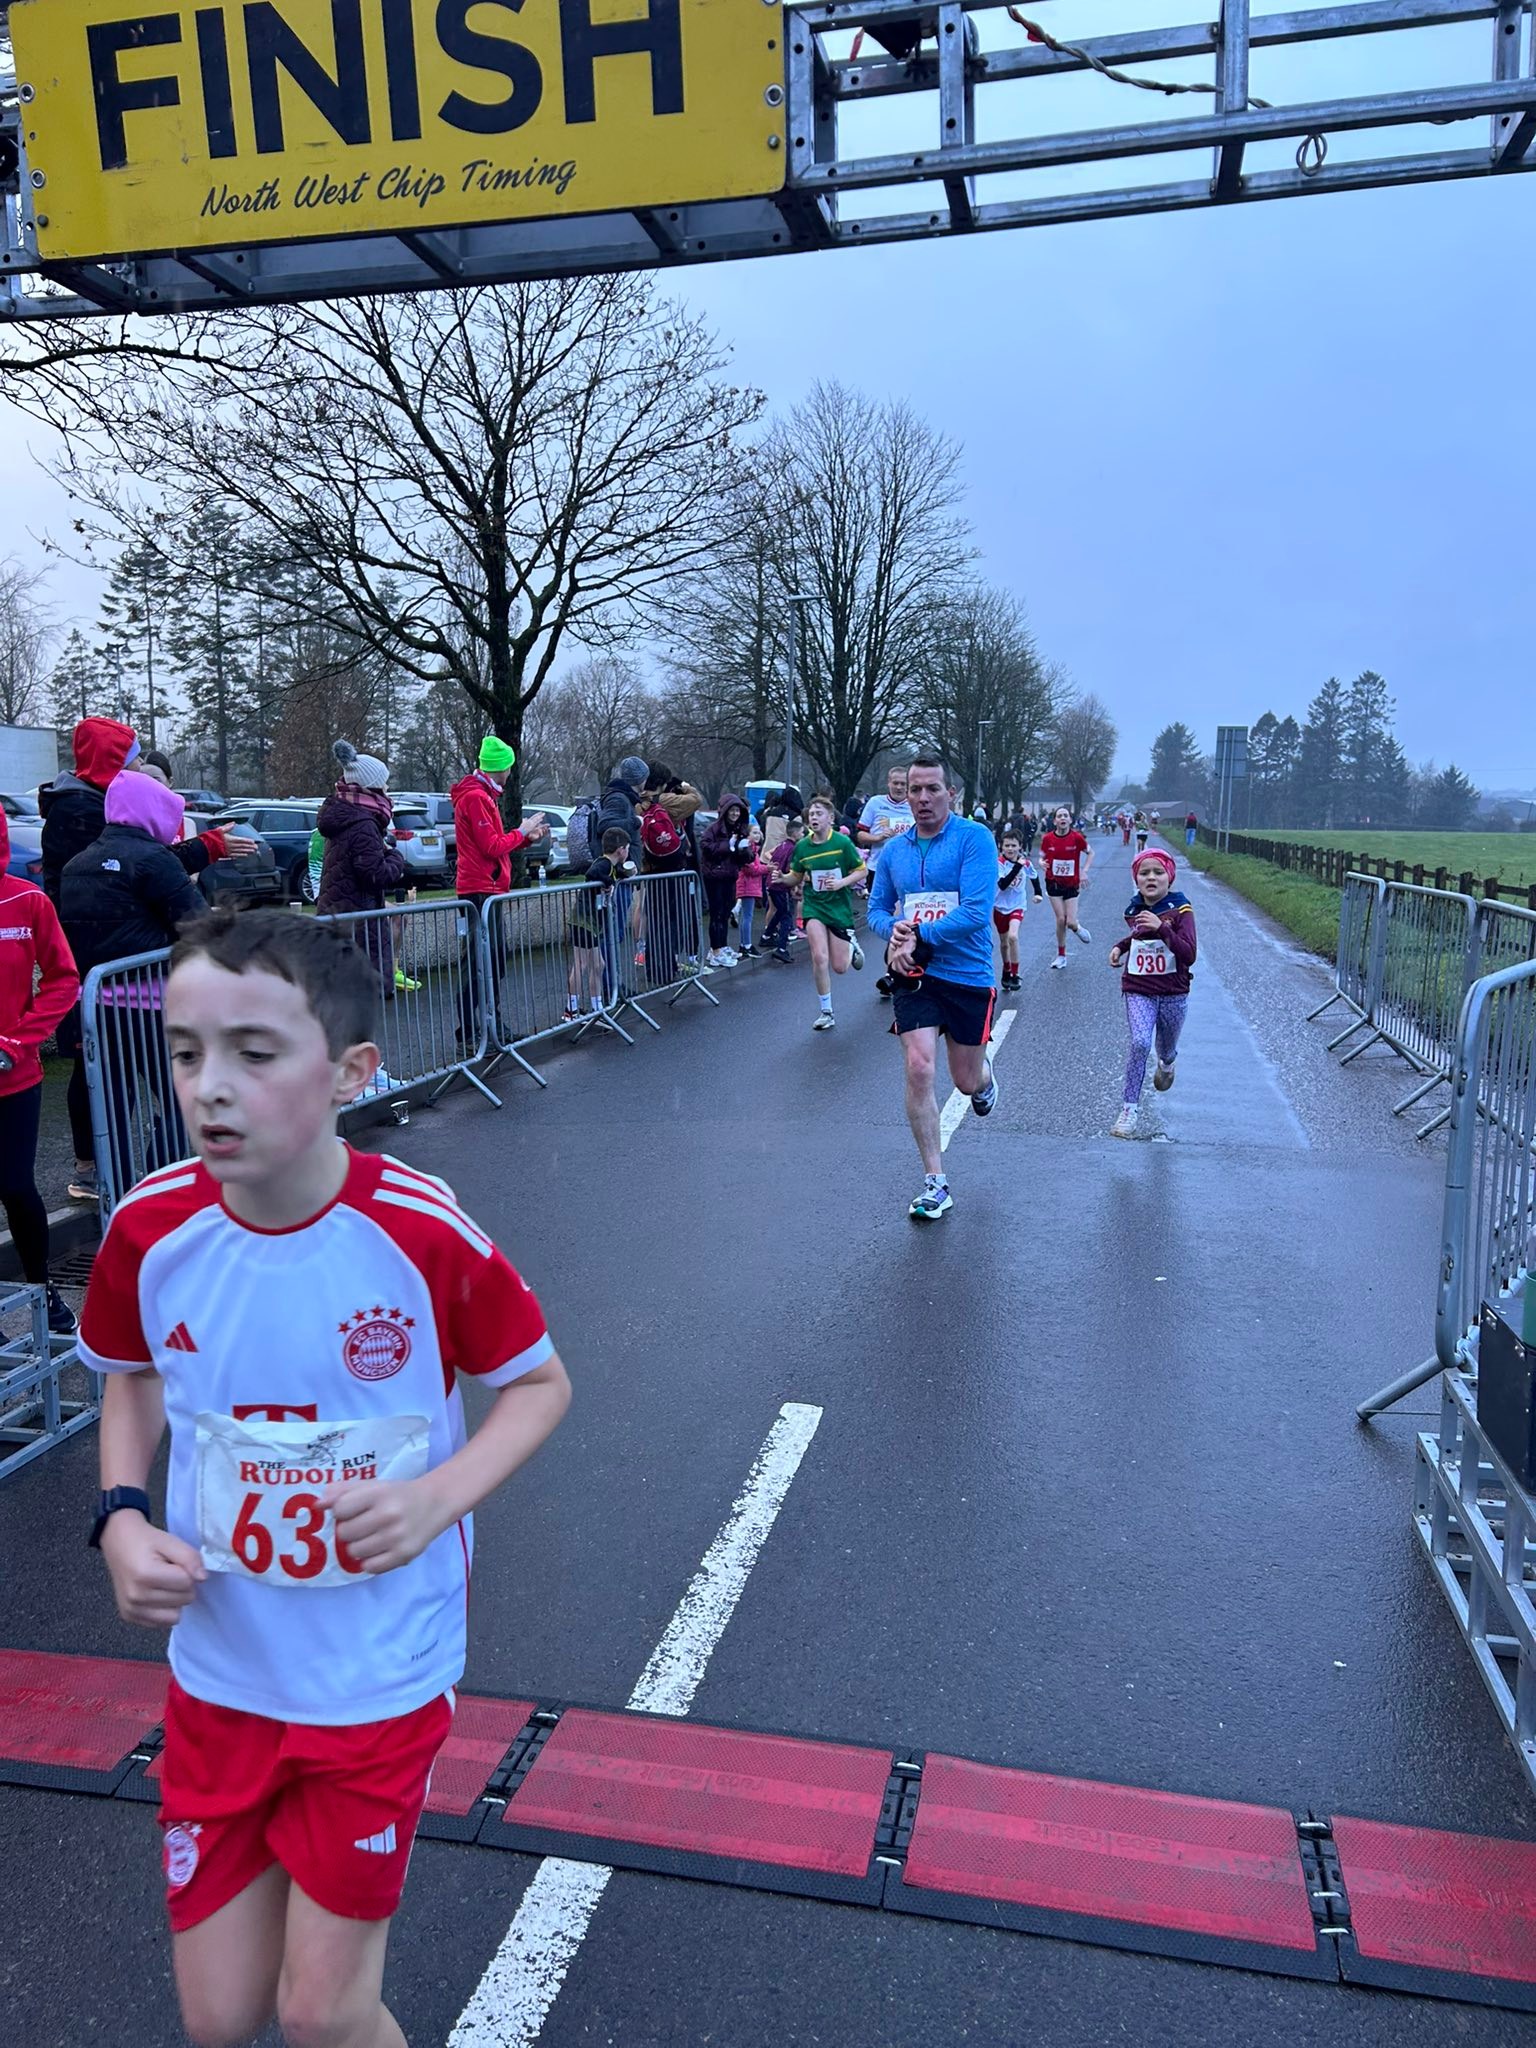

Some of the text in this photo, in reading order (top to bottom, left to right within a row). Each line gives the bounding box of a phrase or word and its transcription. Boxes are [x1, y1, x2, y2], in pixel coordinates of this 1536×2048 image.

[86, 0, 685, 170] FINISH
[201, 157, 577, 217] North West Chip Timing
[1055, 866, 1070, 875] 792
[1136, 954, 1166, 974] 930
[353, 1326, 404, 1350] FC BAYERN
[257, 1450, 376, 1470] THE RUN
[240, 1461, 377, 1485] RUDOLPH
